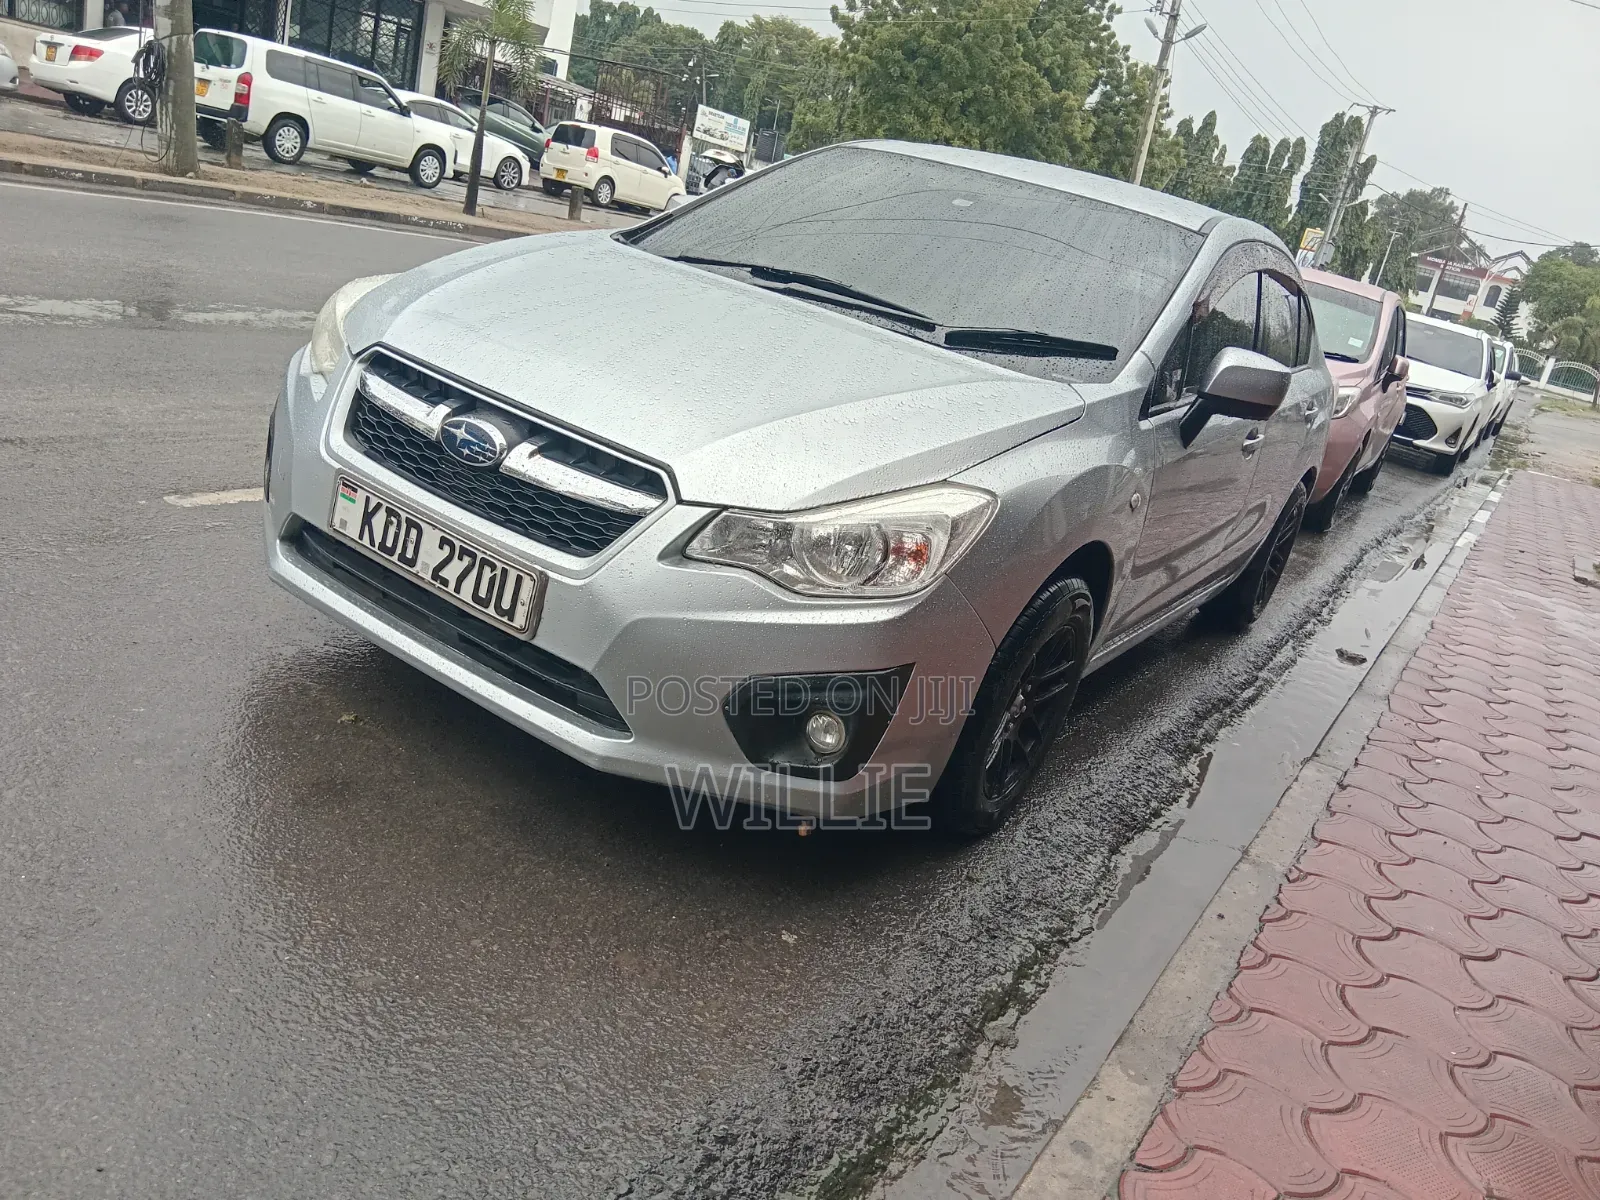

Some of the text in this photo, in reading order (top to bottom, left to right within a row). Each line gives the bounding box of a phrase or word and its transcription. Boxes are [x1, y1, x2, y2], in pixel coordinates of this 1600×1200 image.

[1440, 264, 1461, 272] SATION
[358, 495, 423, 568] KDD
[430, 536, 523, 622] 270U
